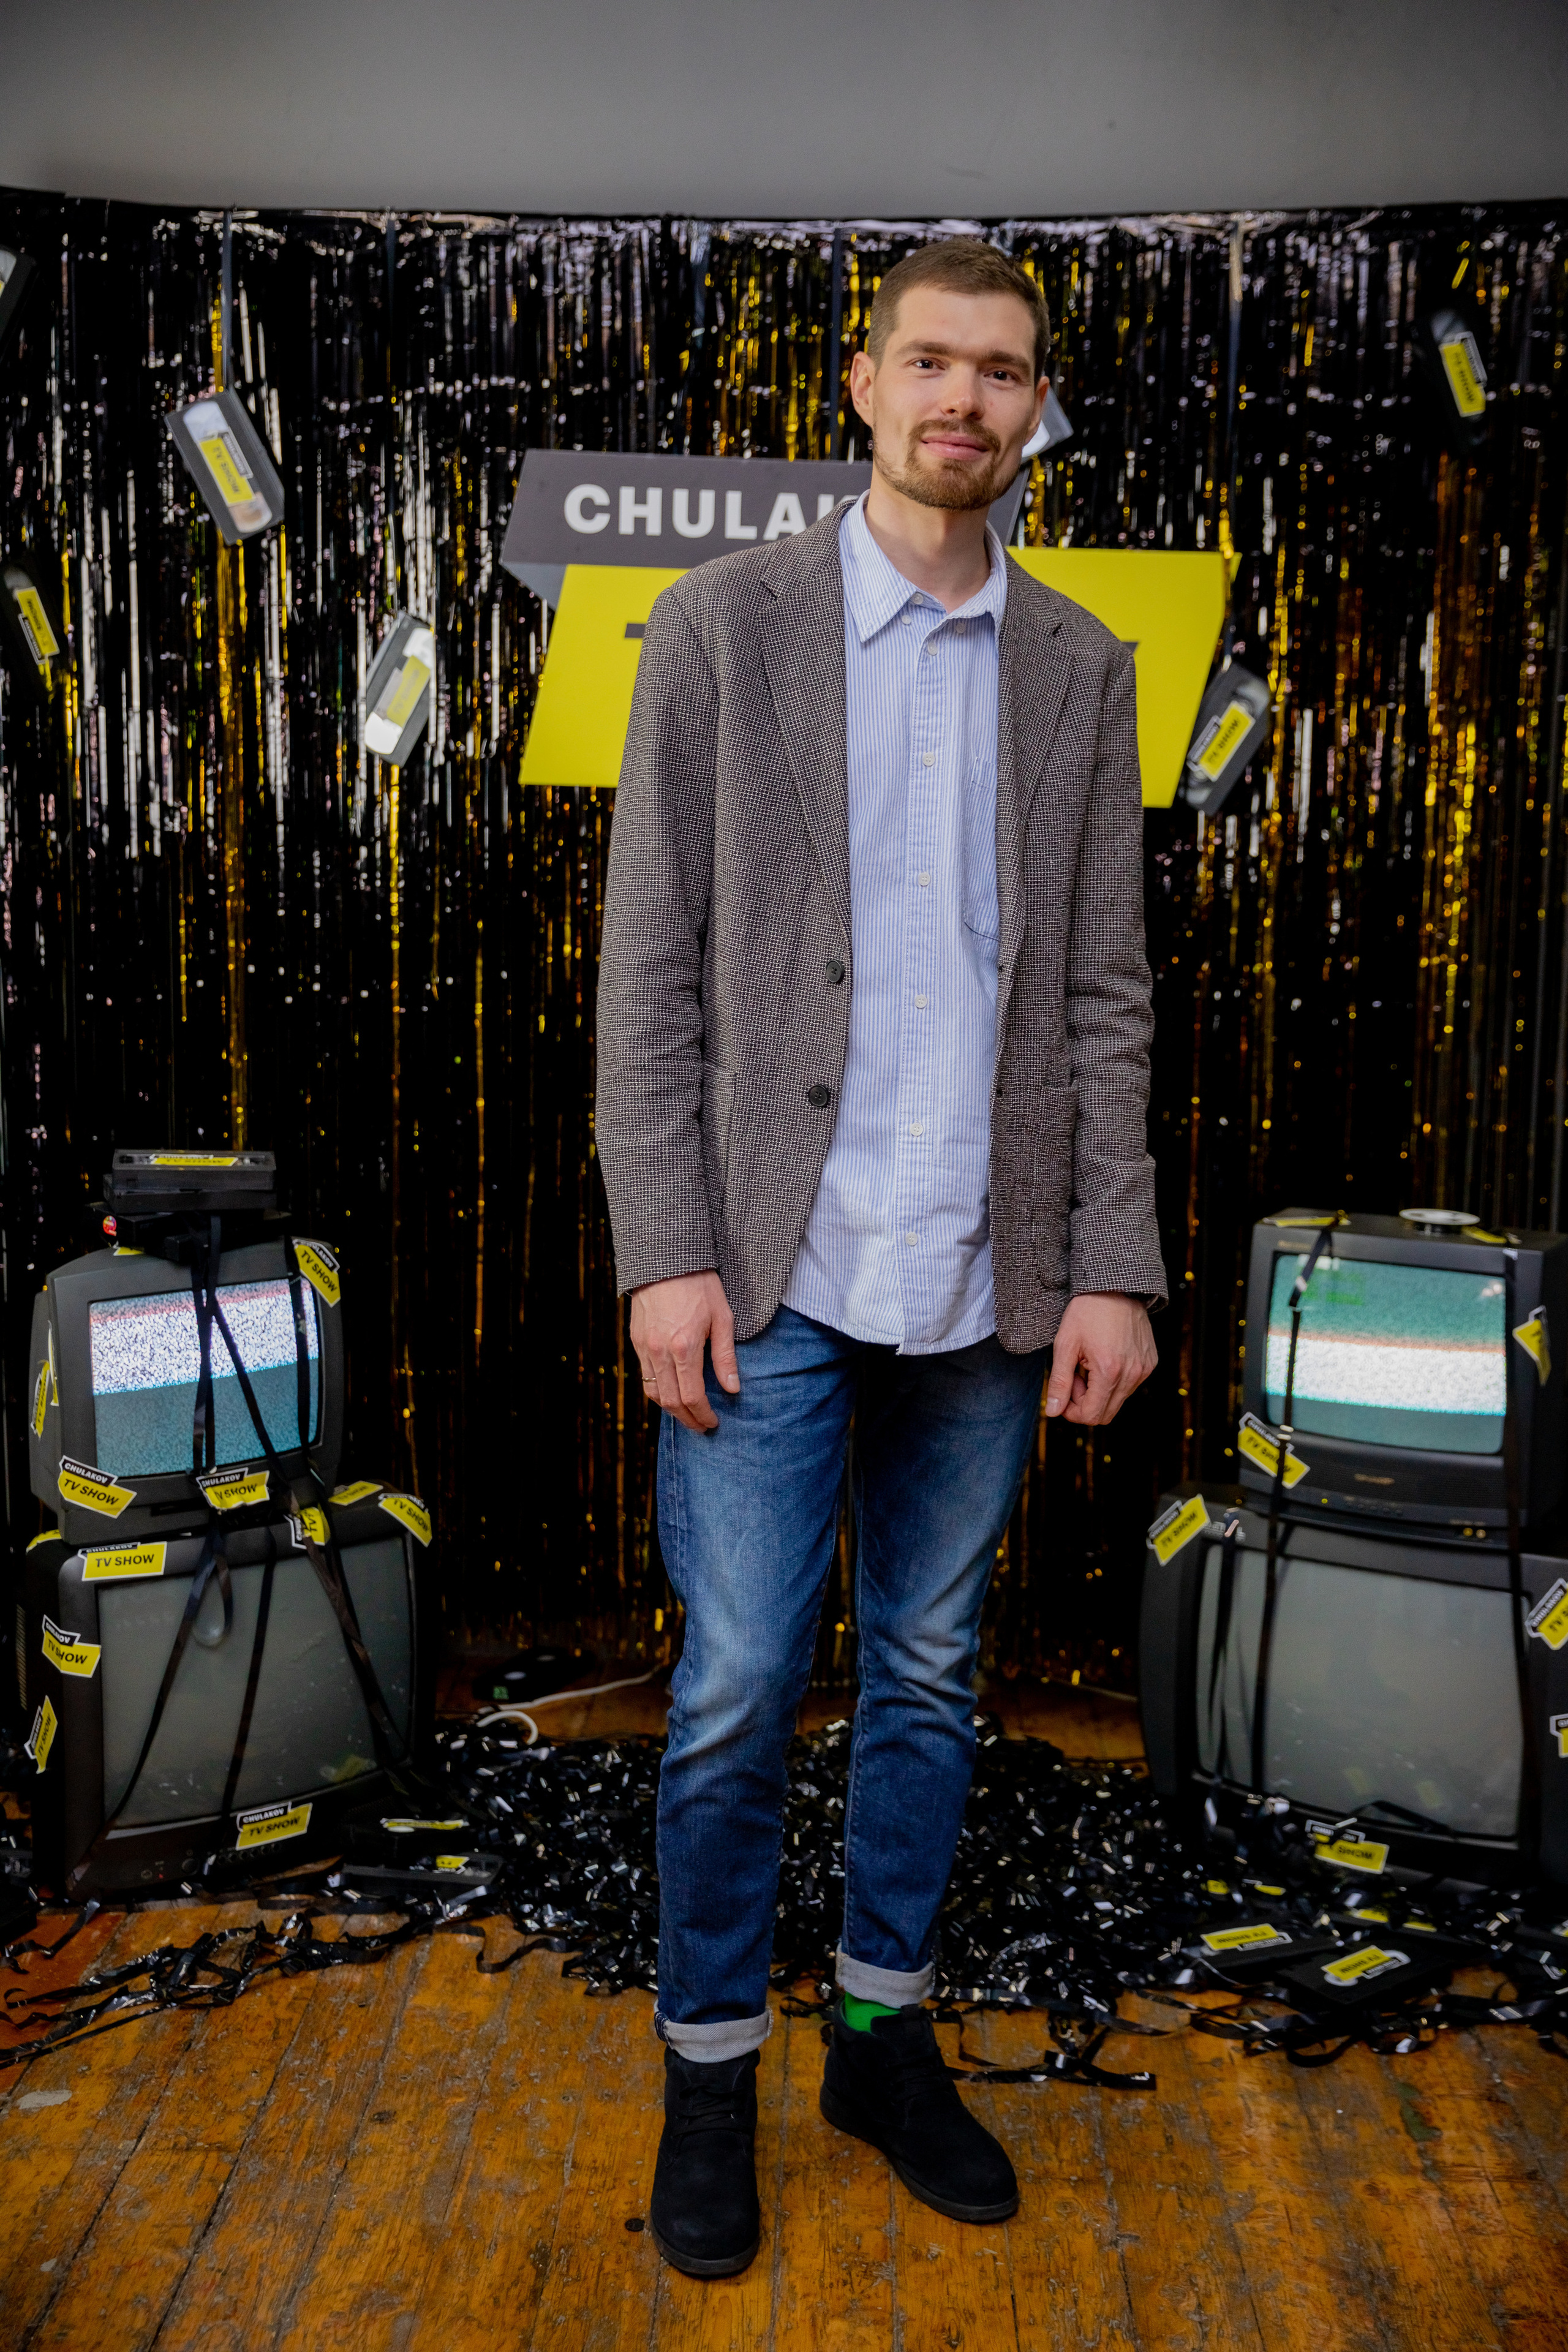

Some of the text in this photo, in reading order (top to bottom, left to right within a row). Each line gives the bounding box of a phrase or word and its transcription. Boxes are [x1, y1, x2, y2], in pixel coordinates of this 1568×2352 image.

[301, 1250, 337, 1292] TV SHOW
[64, 1463, 108, 1483] CHULAKOV
[202, 1473, 241, 1487] CHULAKOV
[64, 1479, 119, 1505] TV SHOW
[224, 1483, 257, 1498] SHOW
[394, 1499, 407, 1509] TV
[407, 1507, 429, 1532] SHOW
[96, 1555, 154, 1567] TV SHOW
[48, 1639, 88, 1664] TV SHOW
[243, 1808, 284, 1823] CHULAKOV
[250, 1817, 300, 1836] TV SHOW
